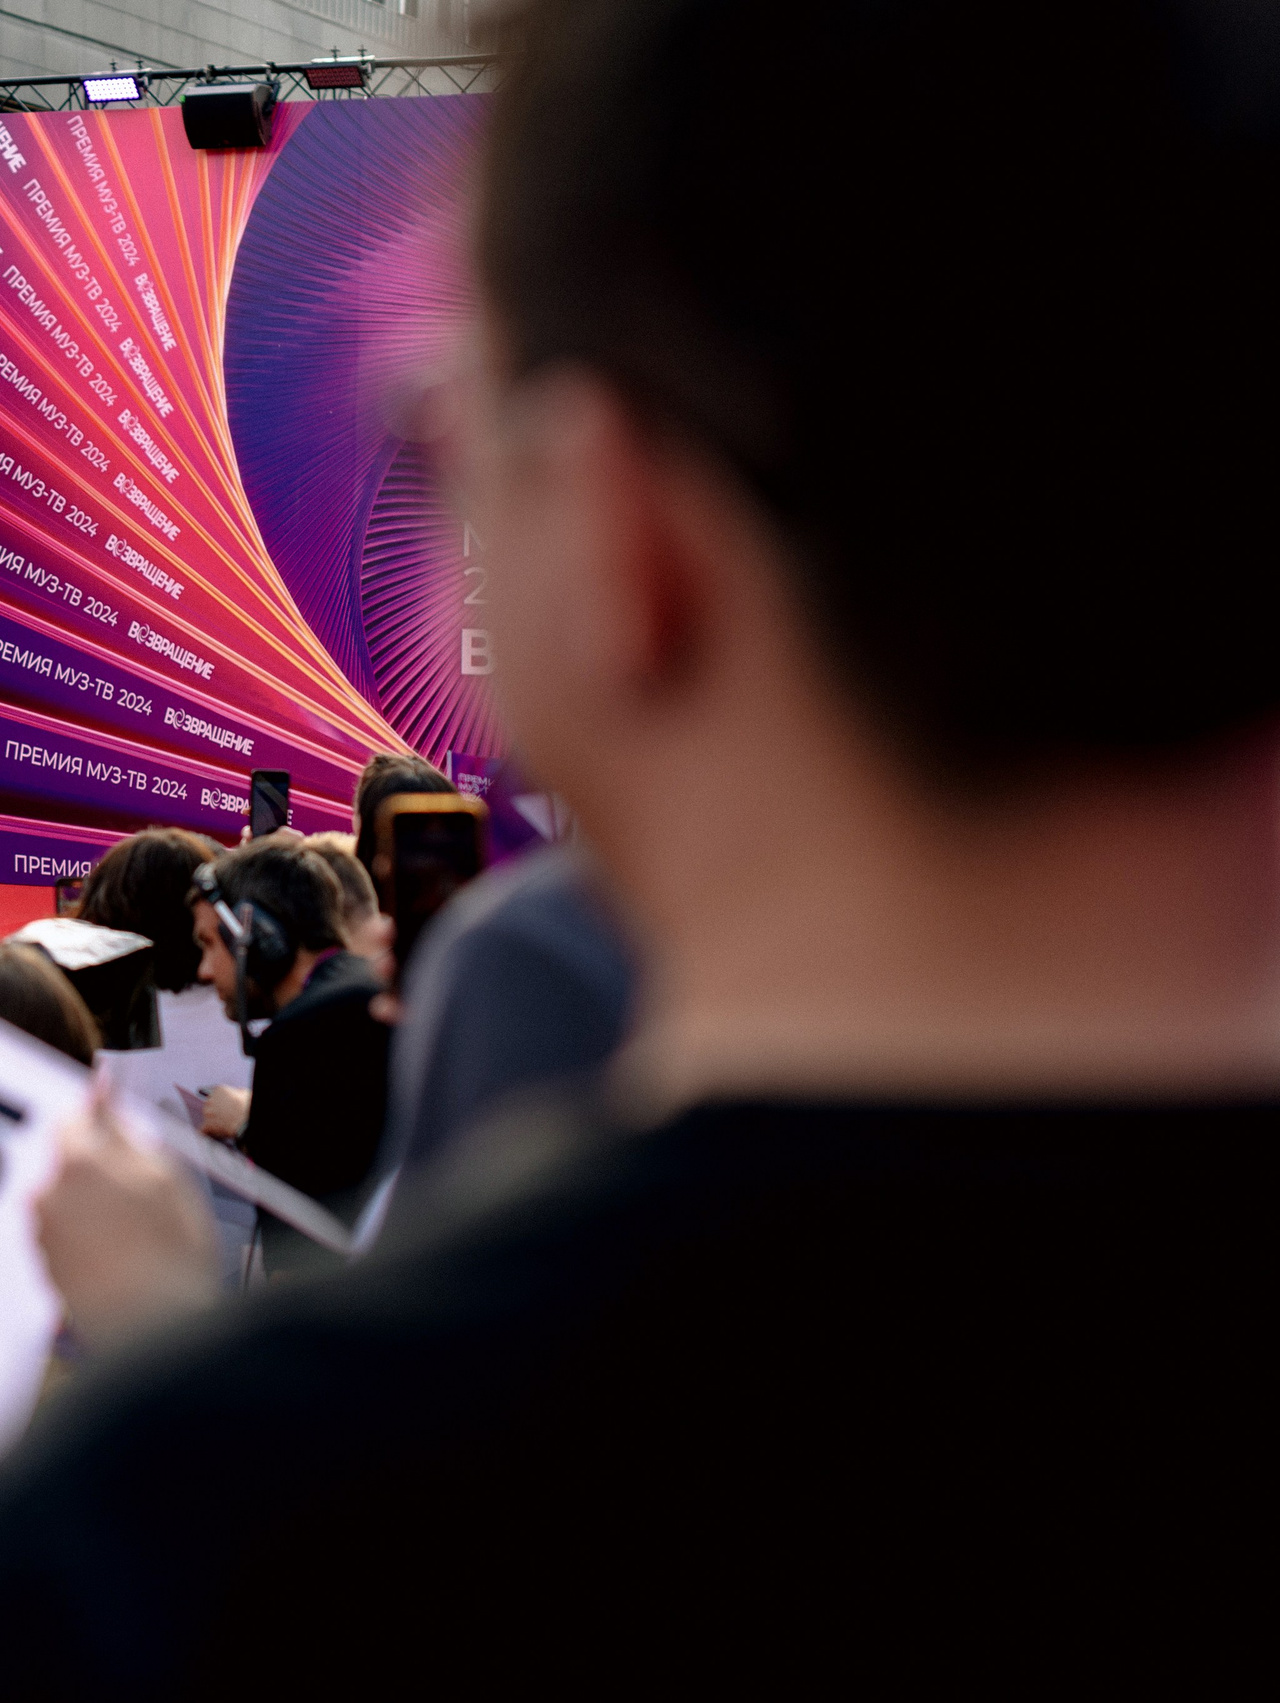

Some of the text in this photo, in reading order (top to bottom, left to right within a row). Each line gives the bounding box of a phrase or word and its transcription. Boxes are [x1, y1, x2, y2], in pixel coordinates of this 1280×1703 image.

[67, 115, 105, 183] ПРЕМИЯ
[95, 181, 127, 234] МУЗ-ТВ
[117, 232, 141, 267] 2024
[23, 178, 72, 249] ПРЕМИЯ
[63, 243, 103, 301] МУЗ-ТВ
[95, 298, 123, 333] 2024
[2, 265, 57, 331] ПРЕМИЯ
[50, 326, 95, 378] МУЗ-ТВ
[88, 373, 119, 407] 2024
[37, 397, 85, 447] МУЗ-ТВ
[80, 440, 112, 473] 2024
[11, 465, 67, 514] МУЗ-ТВ
[65, 505, 100, 538] 2024
[105, 534, 185, 601] ВОЗВРАЩЕНИЕ
[24, 562, 83, 608] МУЗ-ТВ
[83, 597, 119, 627] 2024
[128, 620, 215, 680] ВОЗВРАЩЕНИЕ
[54, 662, 115, 701] МУЗ-ТВ
[116, 688, 153, 717] 2024
[164, 707, 255, 757] ВОЗВРАЩЕНИЕ
[5, 740, 83, 776] ПРЕМИЯ
[86, 760, 147, 791] МУЗ-ТВ
[151, 777, 188, 801] 2024
[14, 854, 92, 877] ПРЕМИЯ
